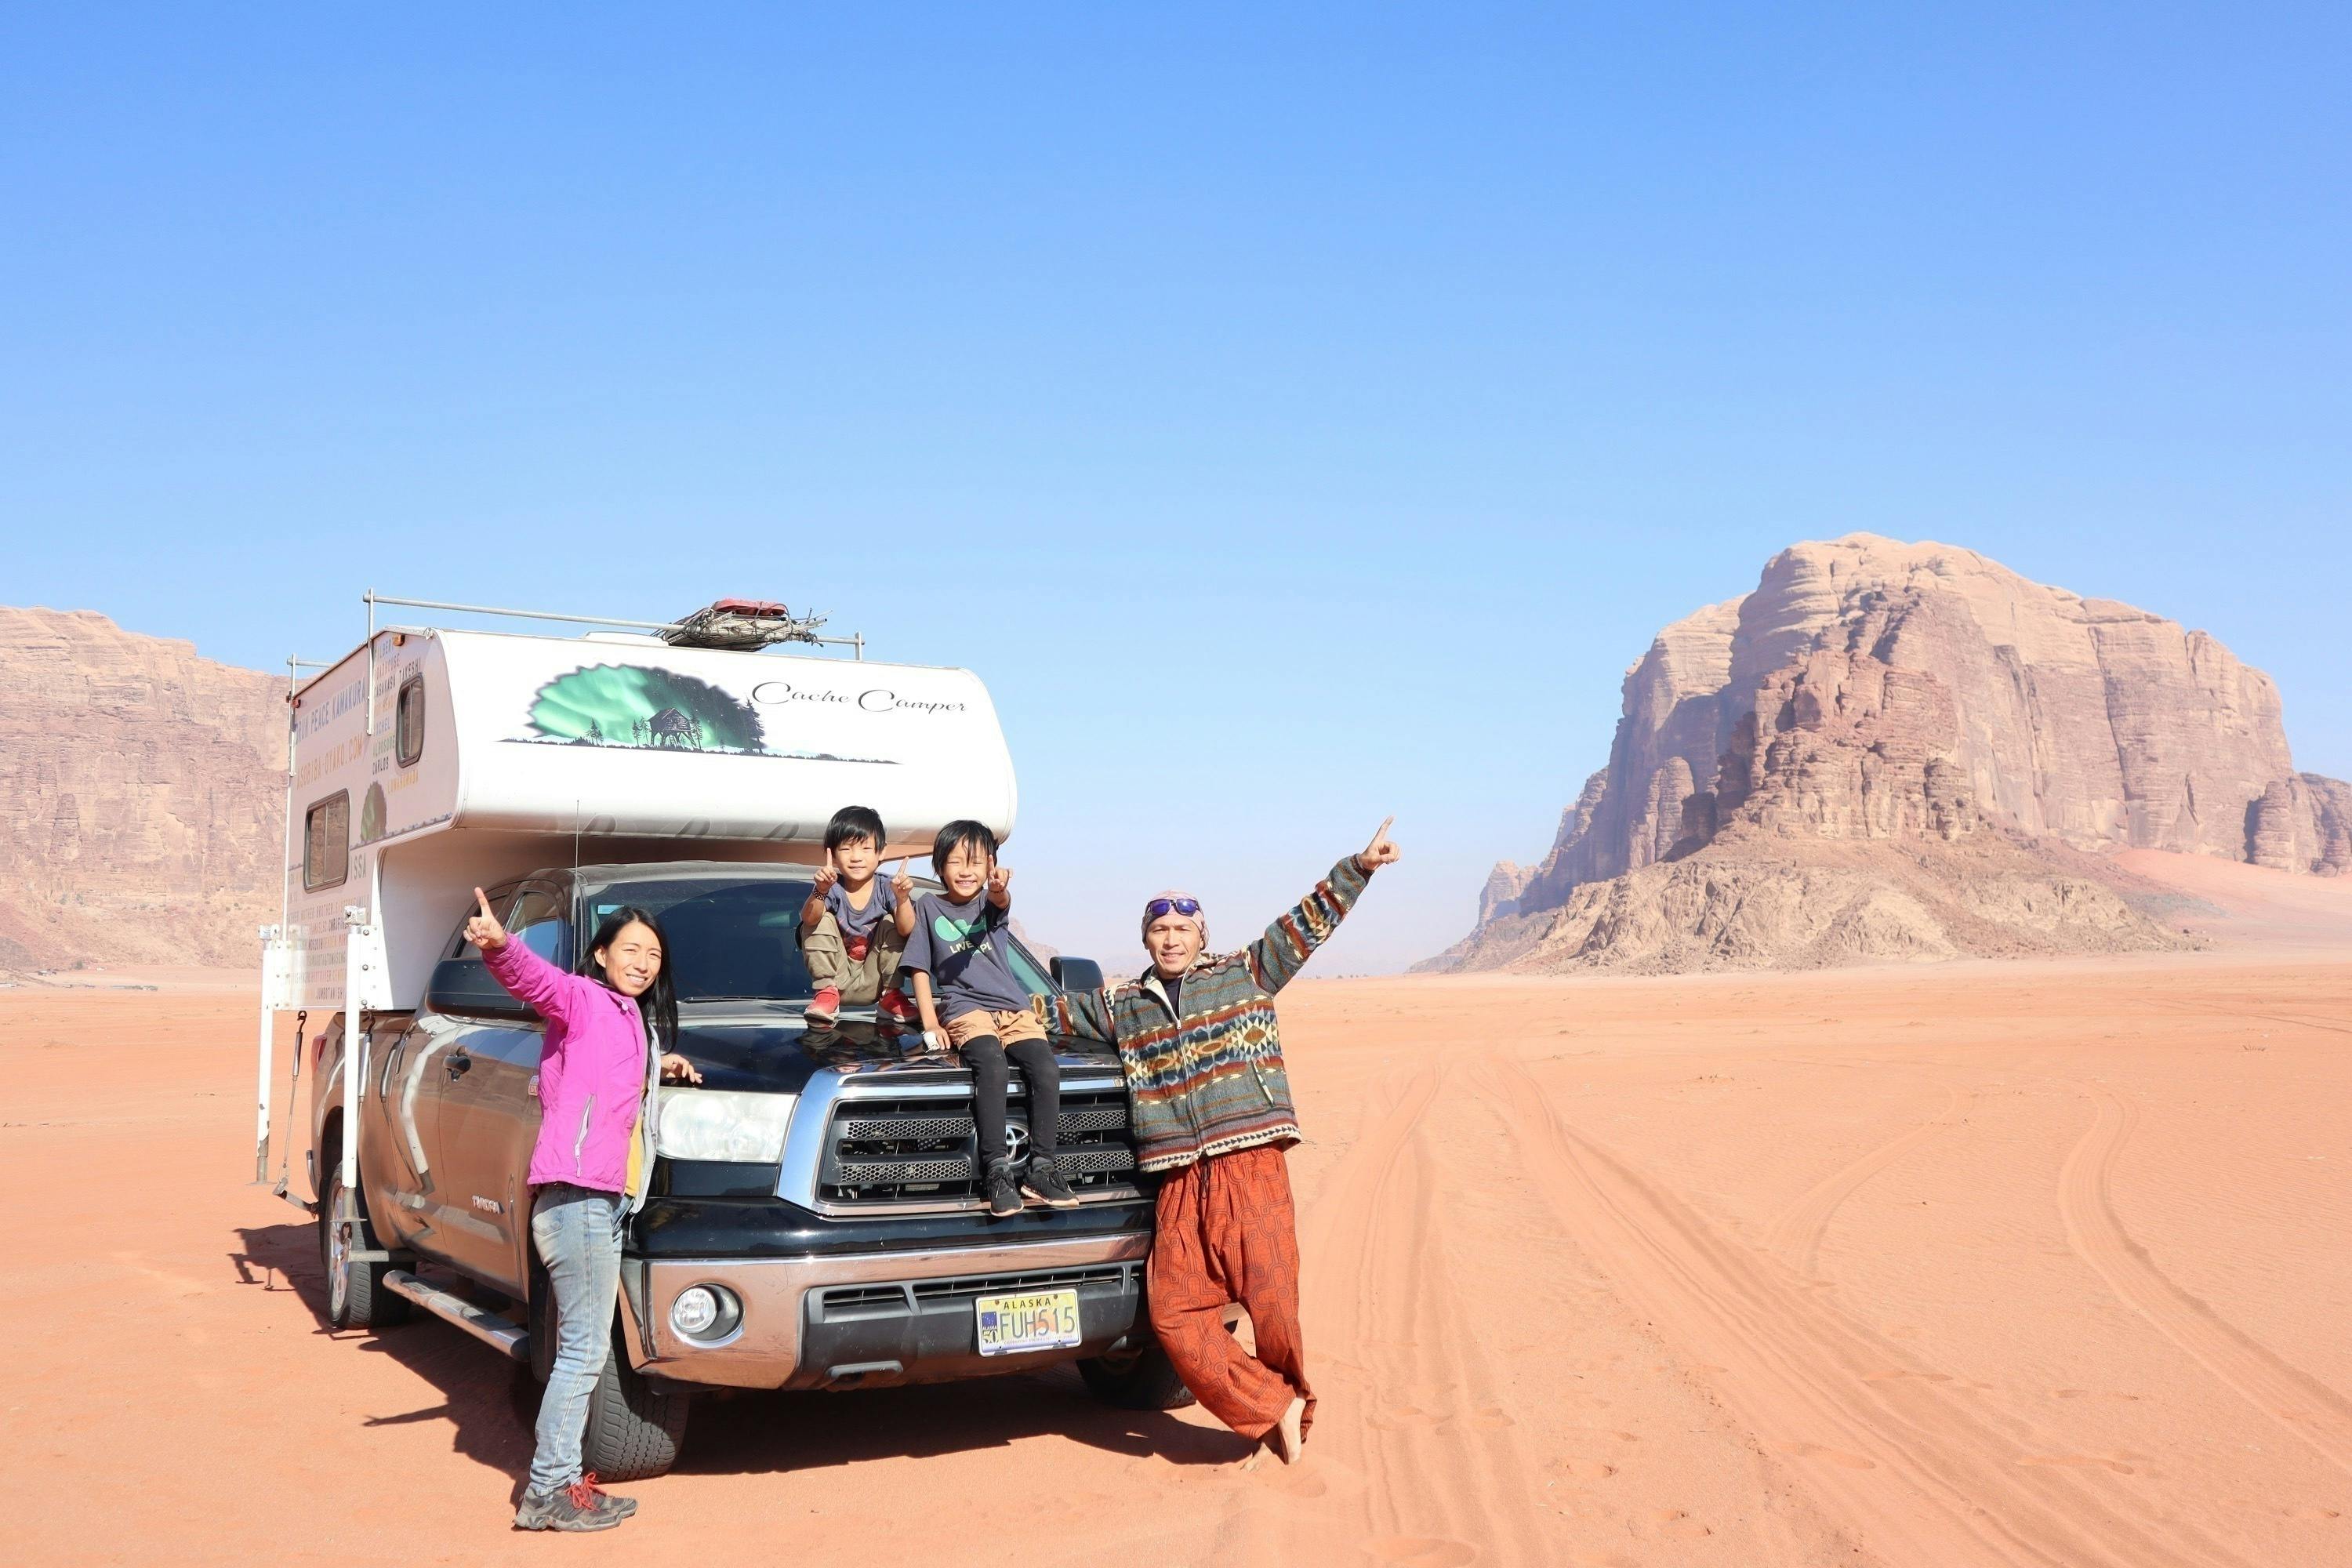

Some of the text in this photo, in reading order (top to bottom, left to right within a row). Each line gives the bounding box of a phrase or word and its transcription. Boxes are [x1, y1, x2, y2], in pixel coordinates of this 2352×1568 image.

[399, 657, 422, 684] TAKESHI
[311, 701, 329, 735] PEACE
[332, 677, 365, 720] KAMAKURA
[751, 681, 967, 714] Cache Camper
[372, 756, 390, 775] CARLOS
[350, 852, 367, 880] ISSA
[949, 940, 974, 954] LIVE
[1003, 1298, 1051, 1310] ALASKA
[1000, 1306, 1076, 1341] FUH515
